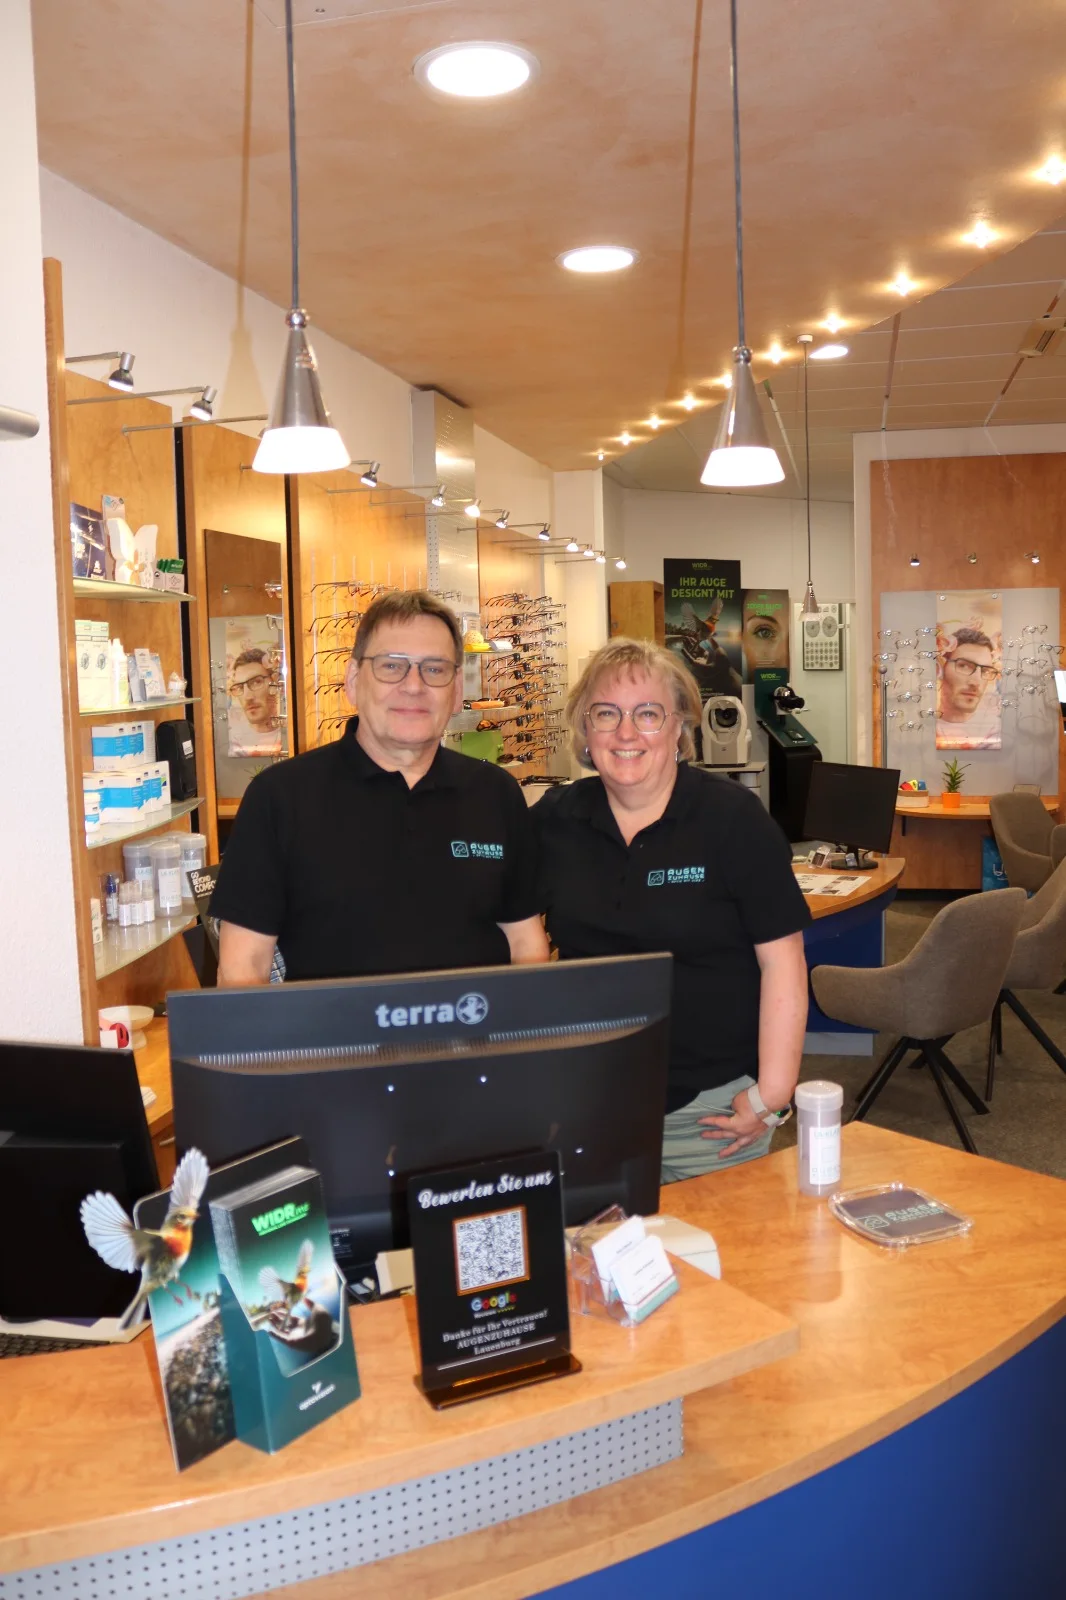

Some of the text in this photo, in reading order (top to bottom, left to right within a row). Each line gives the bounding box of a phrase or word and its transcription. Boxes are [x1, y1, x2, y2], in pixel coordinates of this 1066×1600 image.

[679, 577, 727, 587] IHR AUGE
[671, 588, 735, 599] DESIGNT MIT
[470, 843, 503, 851] AUGEN
[667, 866, 705, 875] AUGEN
[375, 1003, 455, 1027] terra
[497, 1173, 523, 1194] Sie
[524, 1170, 554, 1188] uns
[470, 1291, 517, 1312] Google
[443, 1308, 548, 1343] Danke für Ihr Vertrauen!
[457, 1322, 536, 1349] AUGENZUHAUSE
[474, 1337, 521, 1355] Lauenburg
